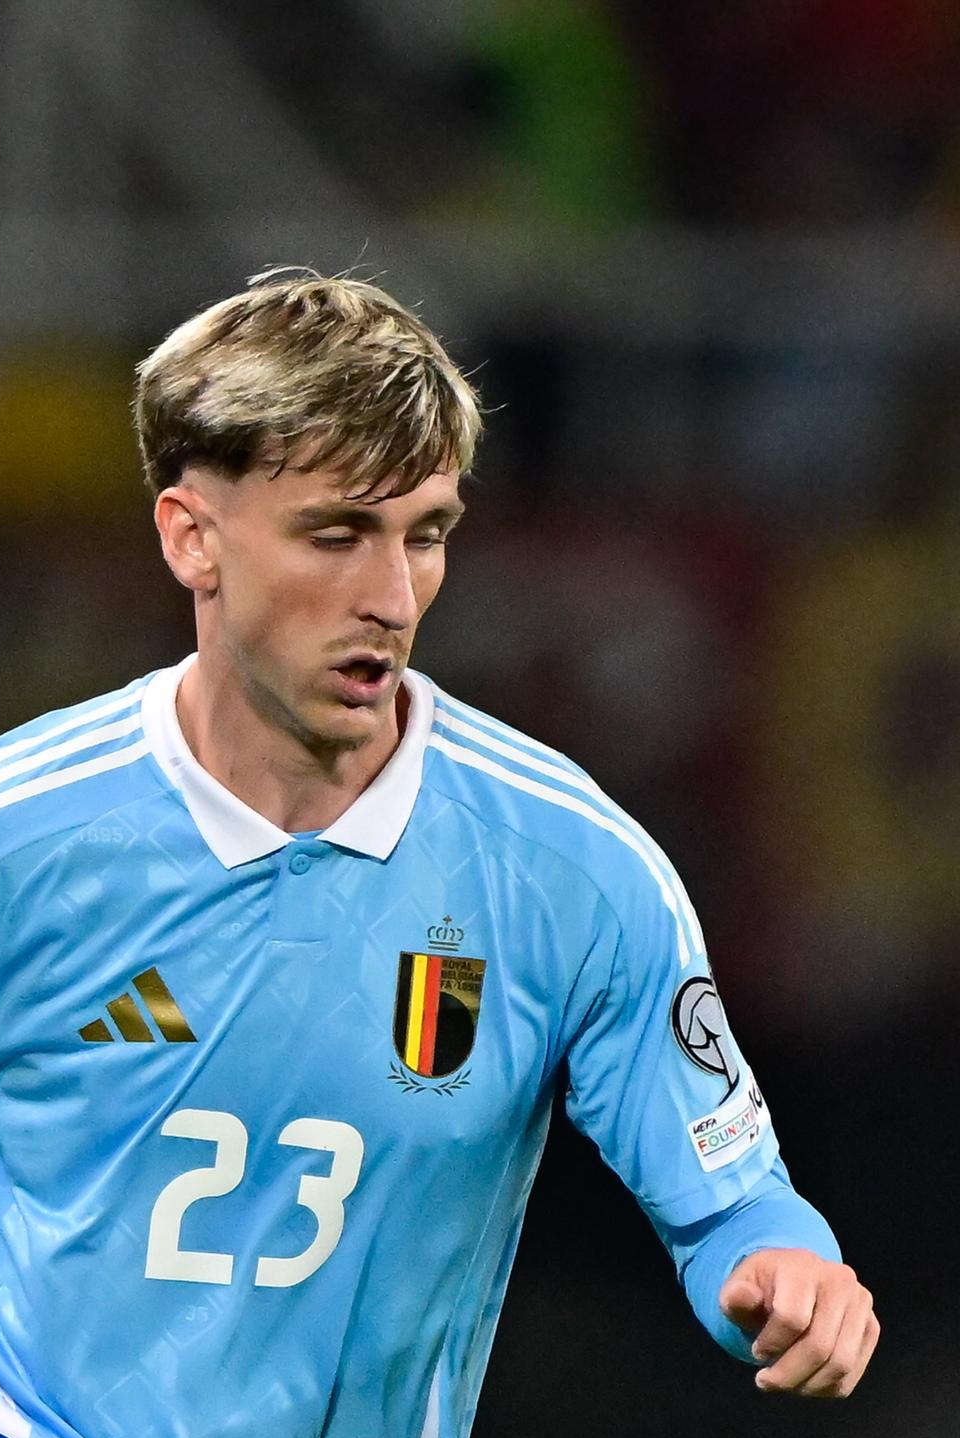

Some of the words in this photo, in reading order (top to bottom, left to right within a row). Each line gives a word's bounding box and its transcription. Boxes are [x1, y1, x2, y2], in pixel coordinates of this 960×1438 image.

[441, 959, 471, 971] ROYAL
[441, 969, 483, 982] BELGIAN
[144, 1108, 364, 1288] 23
